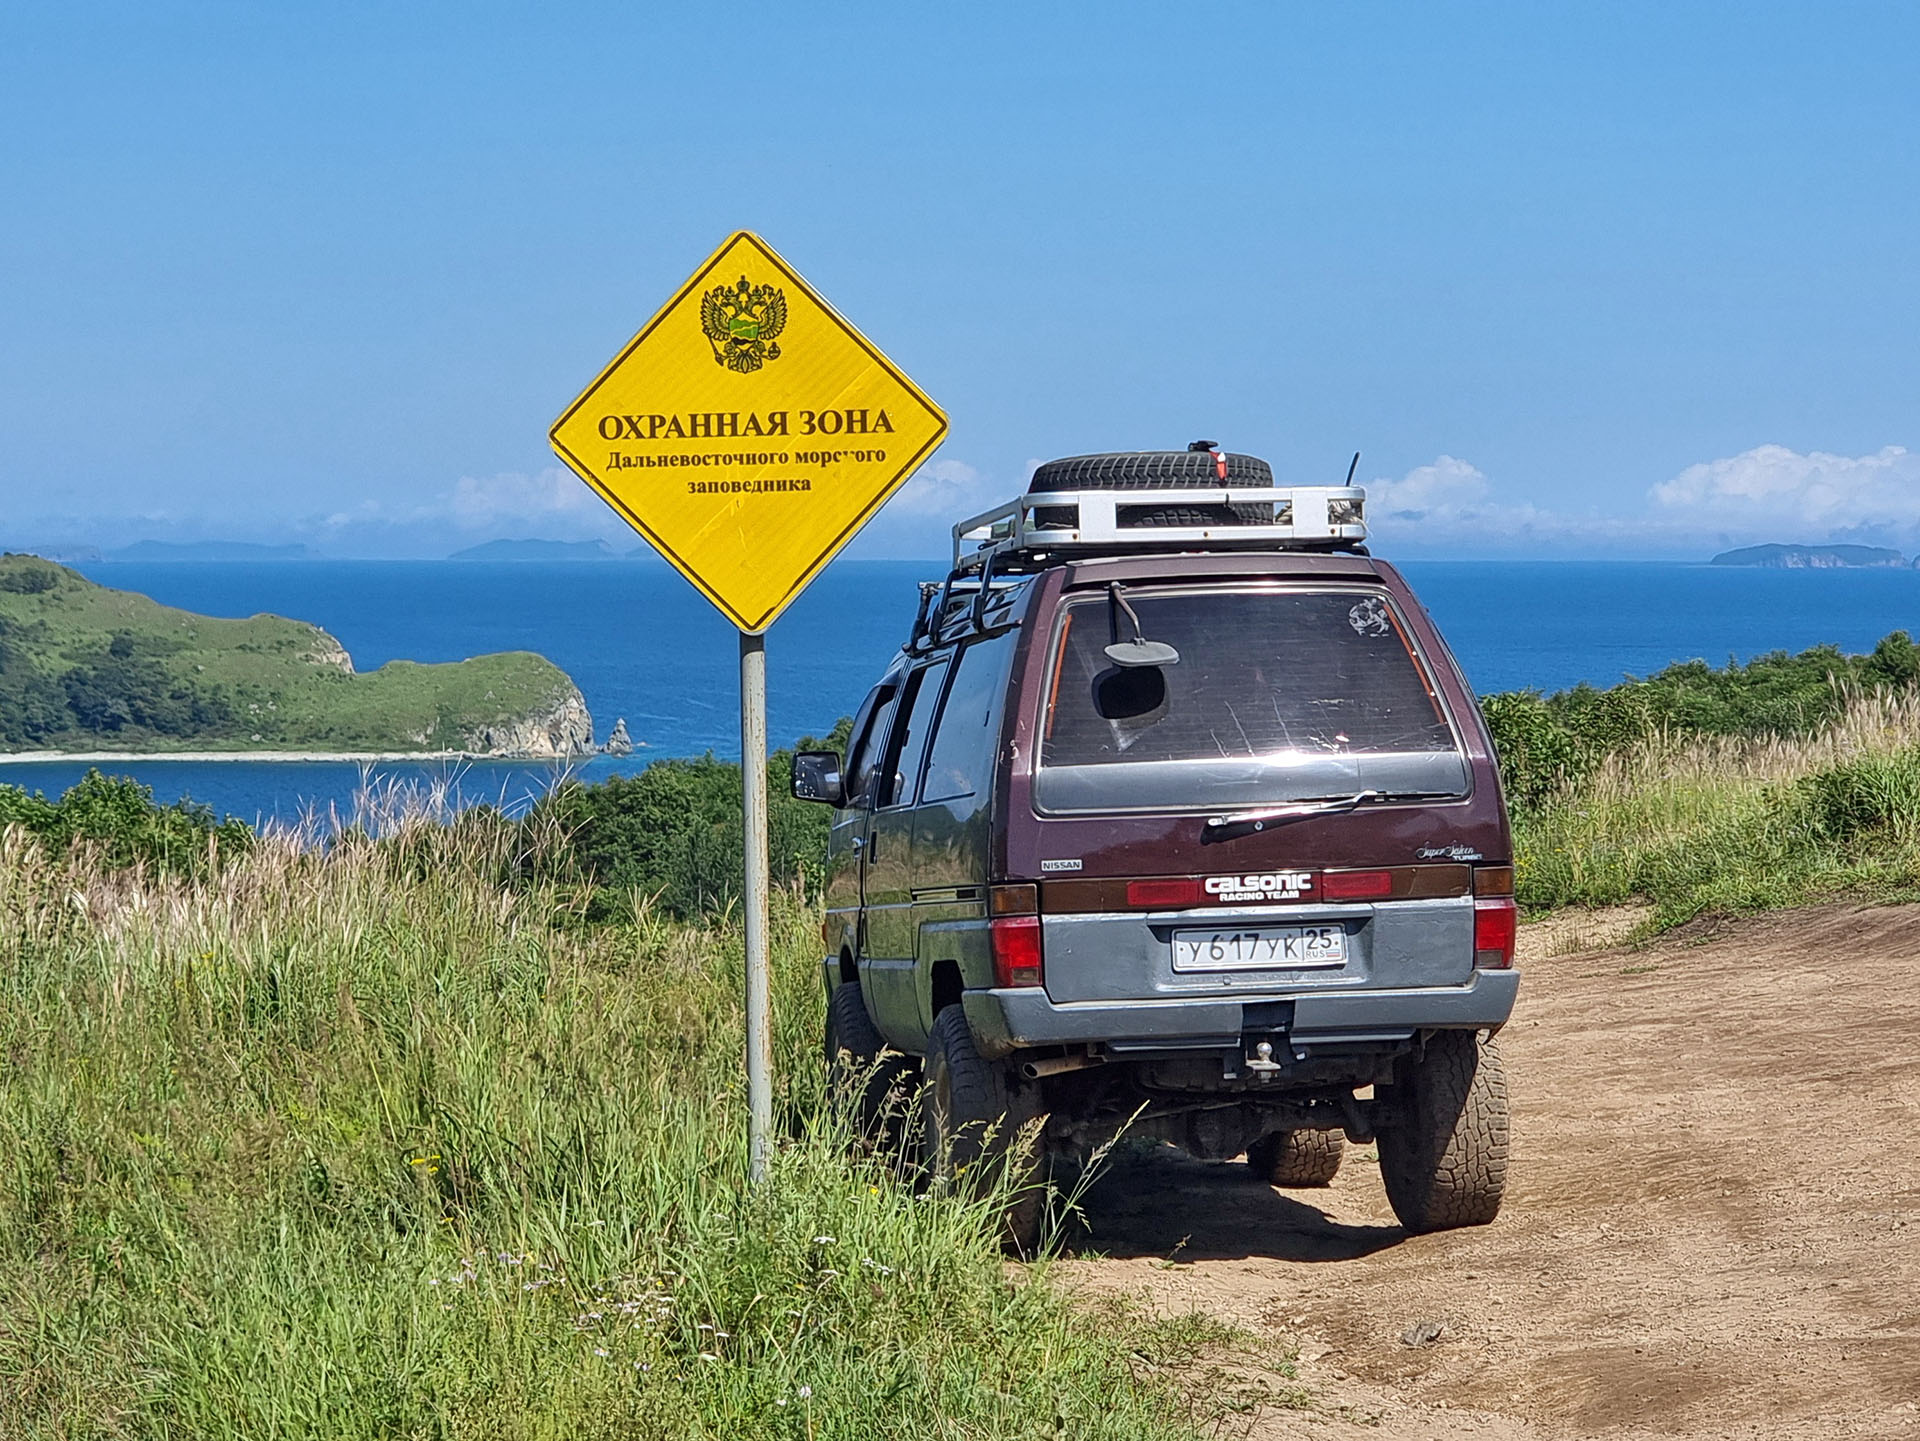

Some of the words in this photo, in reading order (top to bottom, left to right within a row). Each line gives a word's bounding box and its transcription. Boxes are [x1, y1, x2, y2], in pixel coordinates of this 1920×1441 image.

[598, 411, 790, 440] ОХРАННАЯ
[799, 408, 896, 435] ЗОНА
[606, 450, 789, 472] Дальневосточного
[687, 477, 812, 495] заповедника
[1042, 861, 1081, 870] NISSAN
[1219, 891, 1265, 902] RACING
[1265, 889, 1300, 900] TEAM
[1305, 928, 1332, 950] 25
[1305, 950, 1326, 958] RUS
